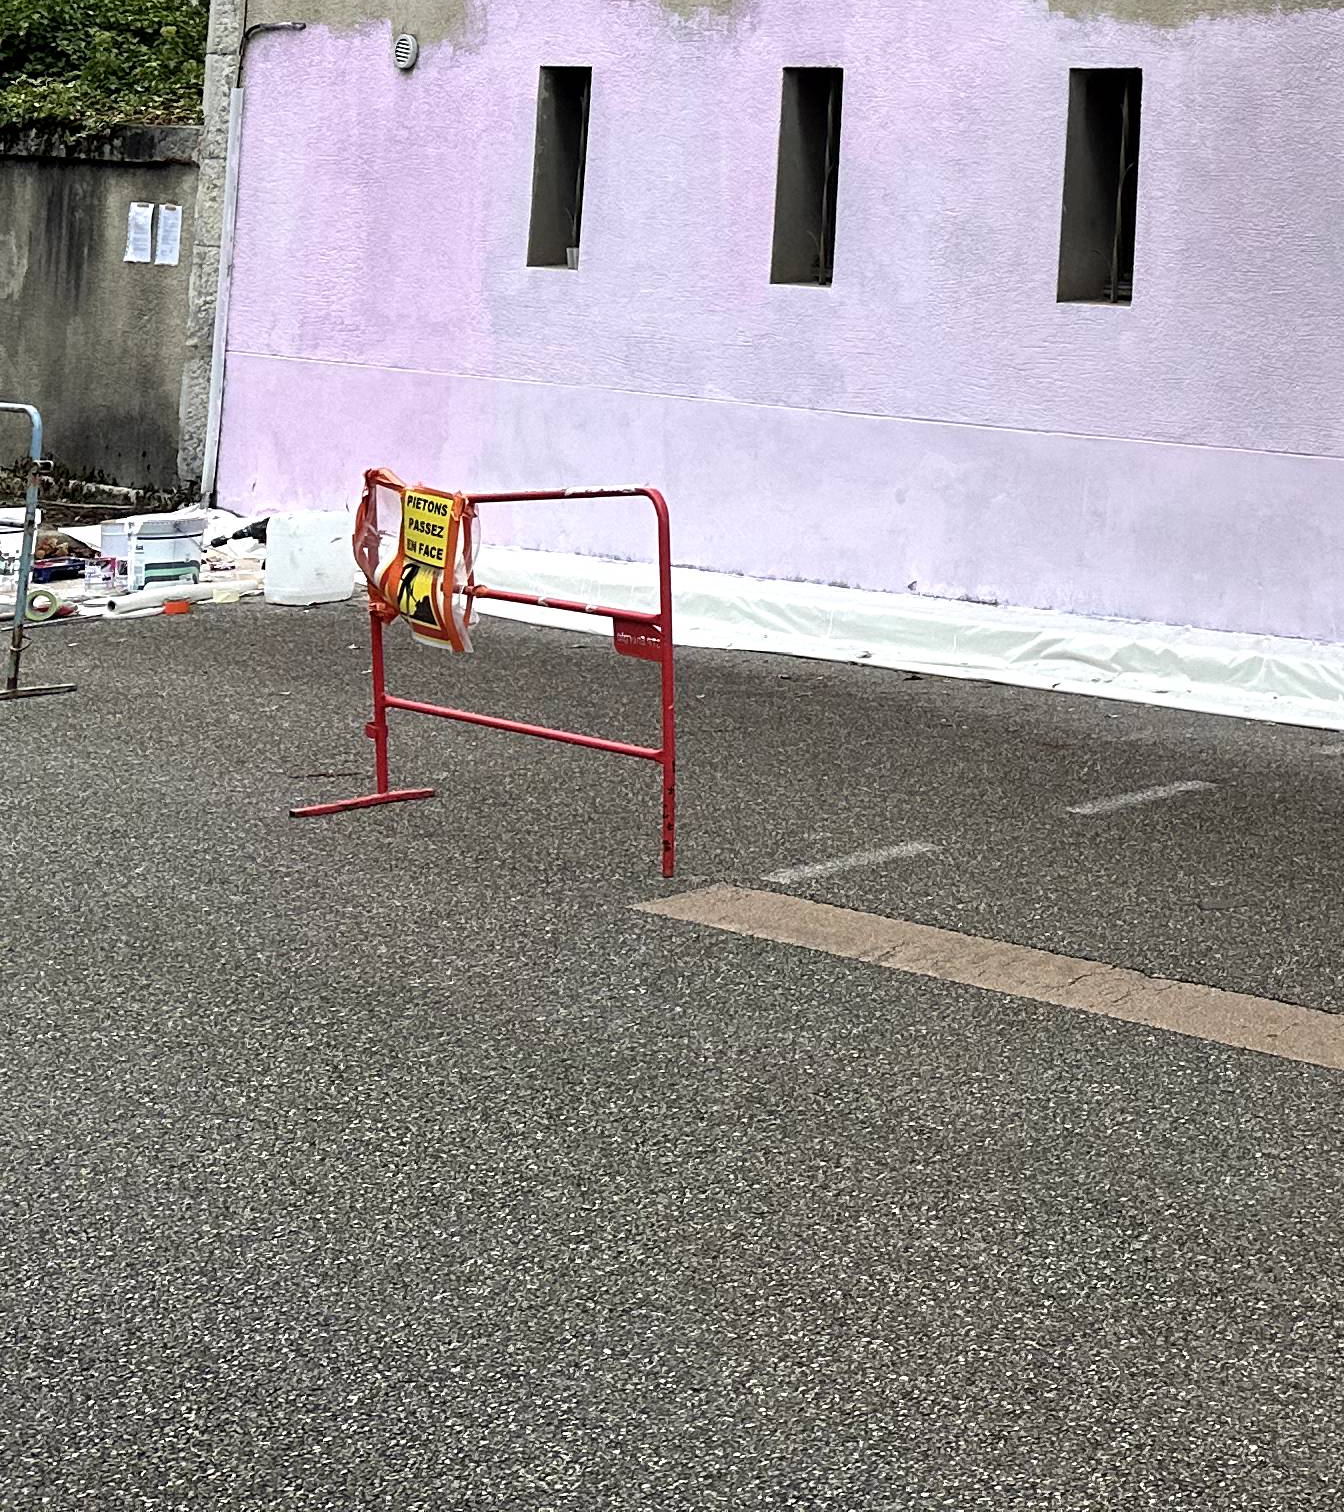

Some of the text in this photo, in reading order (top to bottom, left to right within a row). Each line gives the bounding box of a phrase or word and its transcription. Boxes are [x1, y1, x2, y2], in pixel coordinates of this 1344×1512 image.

[406, 495, 448, 516] PIETONS
[408, 517, 445, 538] PASSEZ
[418, 541, 444, 561] FACE
